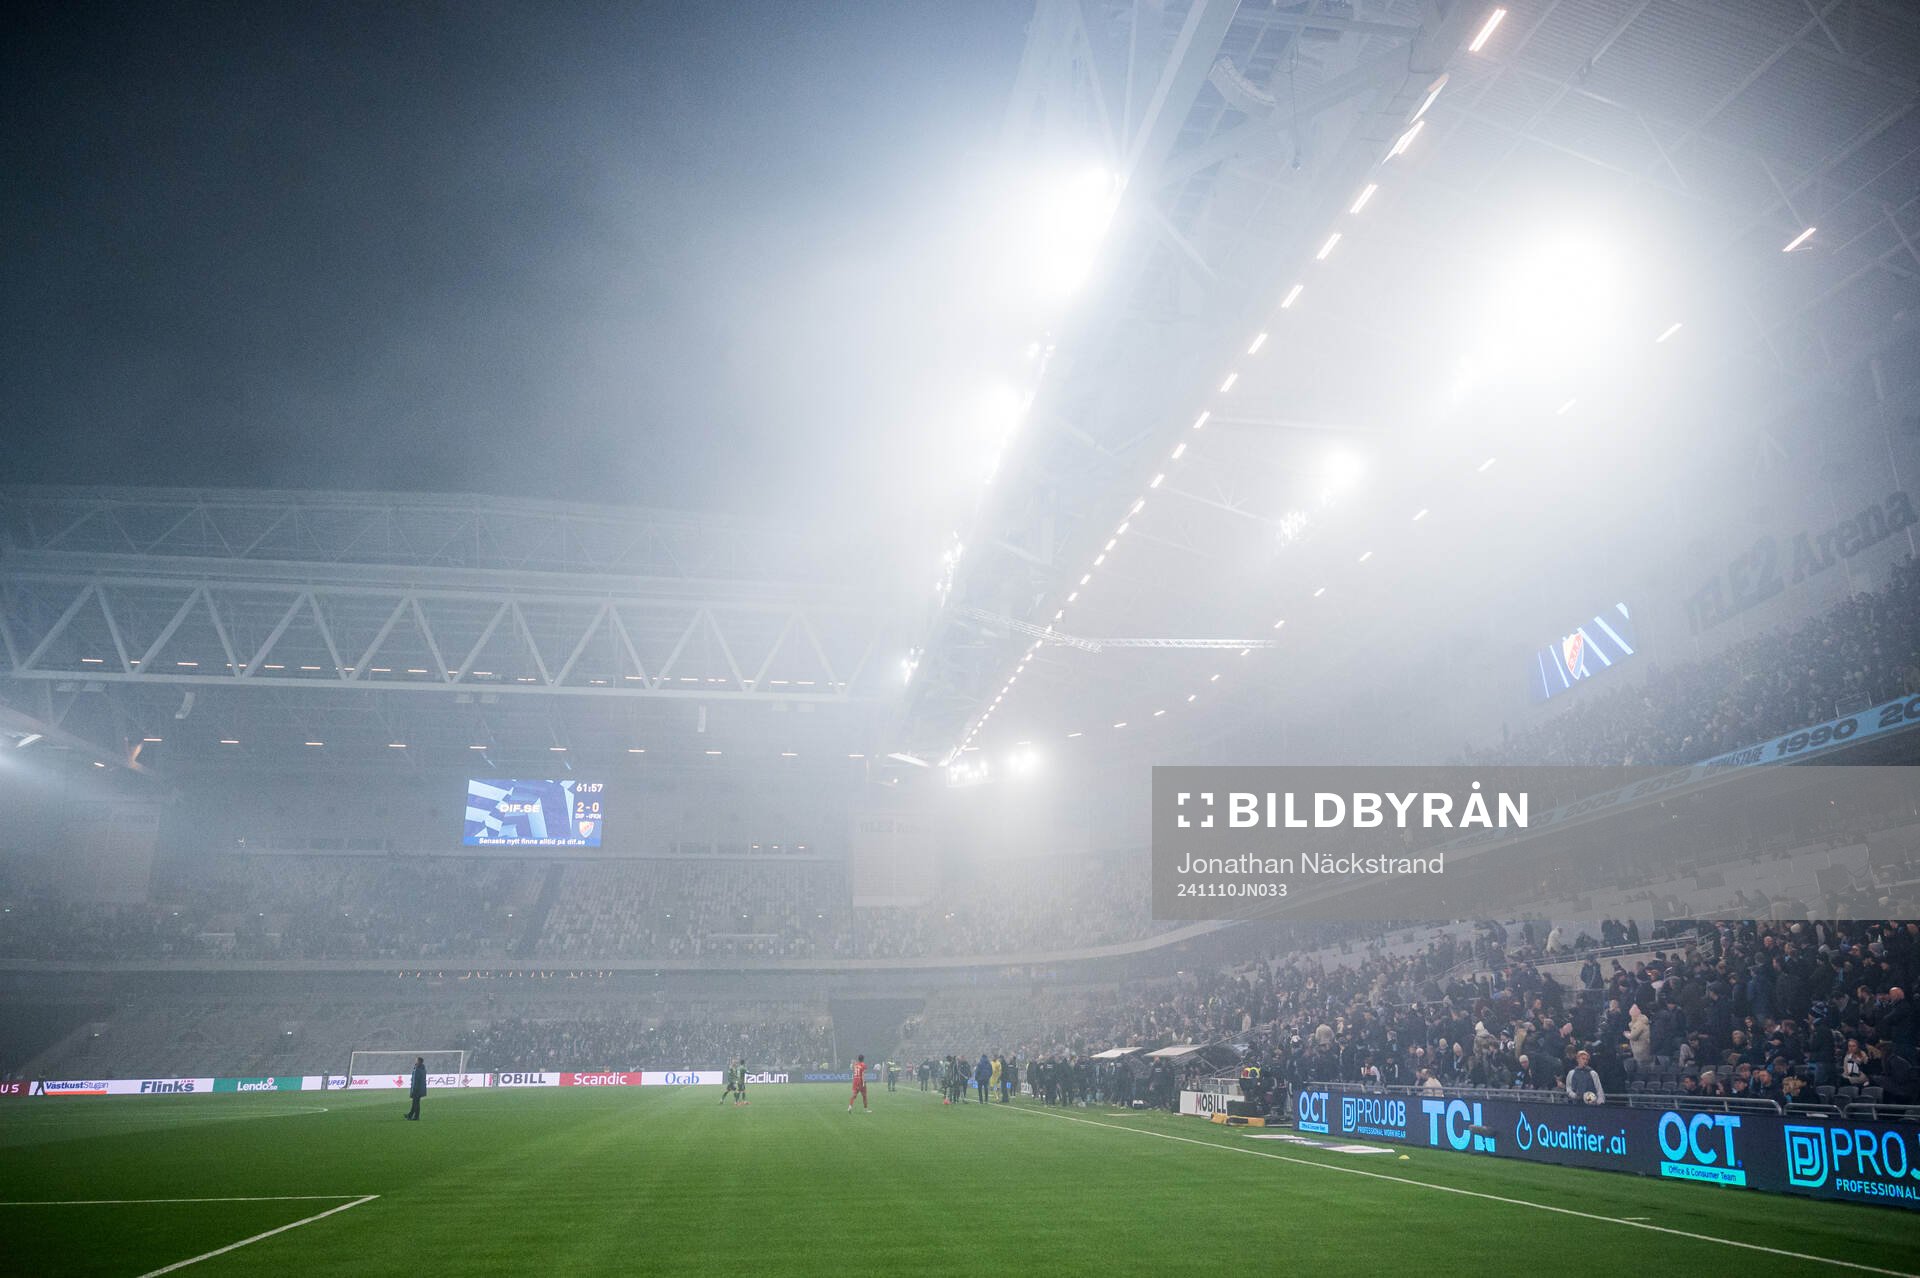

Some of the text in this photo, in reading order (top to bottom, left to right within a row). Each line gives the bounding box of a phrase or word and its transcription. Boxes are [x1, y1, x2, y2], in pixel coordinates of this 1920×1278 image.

[1792, 490, 1919, 584] Arena
[1776, 719, 1858, 755] 1990
[576, 783, 603, 792] 61:57
[499, 804, 541, 813] DIF.SE
[427, 1076, 456, 1085] FAB
[573, 1072, 627, 1085] Scandic
[665, 1072, 700, 1084] Ocab
[744, 1072, 789, 1084] adium
[140, 1080, 194, 1092] Flinks
[1195, 1092, 1227, 1113] MOBILL
[1357, 1099, 1406, 1127] PROJOB
[1537, 1123, 1627, 1155] Qualifier.ai
[1668, 1165, 1684, 1175] Office
[1691, 1168, 1719, 1179] Consumer
[1720, 1171, 1737, 1182] Team
[1836, 1178, 1920, 1200] PROFESSIONAL
